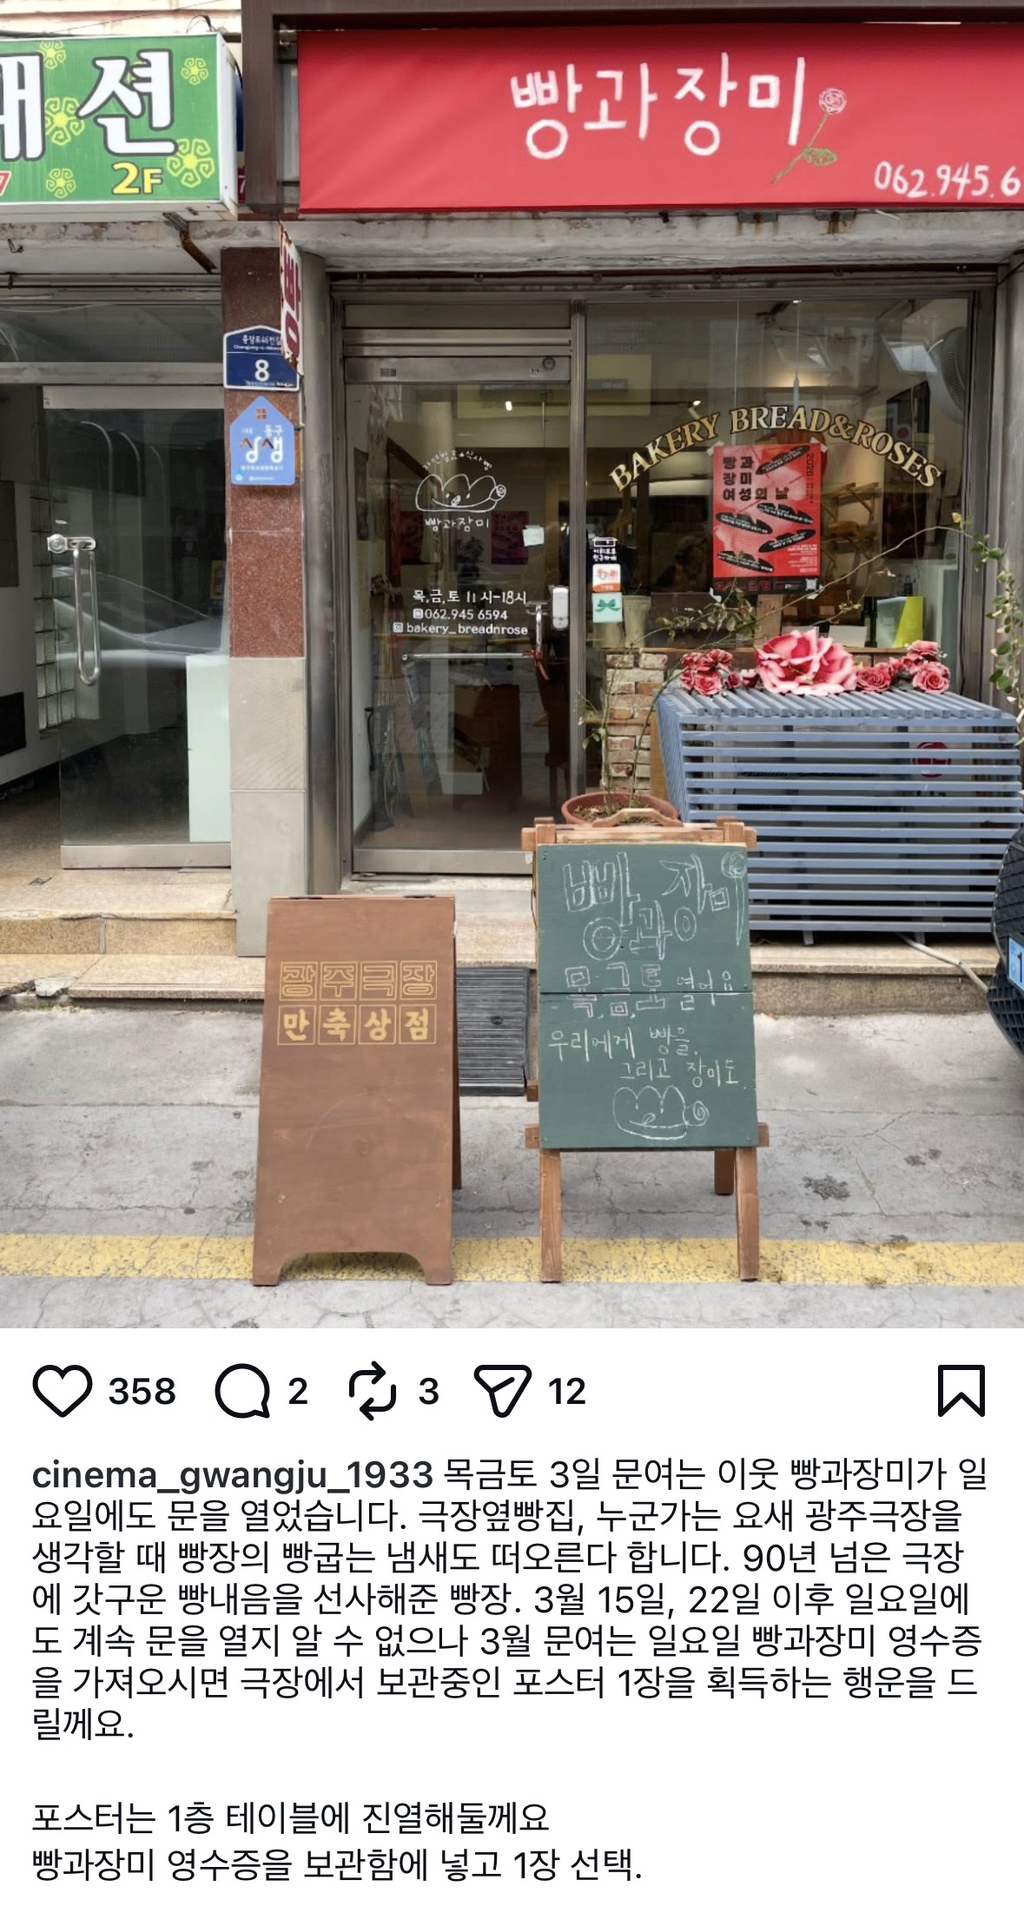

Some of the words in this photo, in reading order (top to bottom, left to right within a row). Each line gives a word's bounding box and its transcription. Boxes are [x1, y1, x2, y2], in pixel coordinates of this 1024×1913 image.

[510, 52, 806, 160] 빵과장미
[112, 161, 164, 196] 2F
[254, 358, 270, 382] 8
[609, 412, 721, 492] BAKERY
[730, 405, 944, 489] BREAD&ROSES
[425, 516, 489, 533] 빵과장미
[406, 622, 528, 635] bakery_breadnrose
[478, 609, 508, 620] 6594
[282, 963, 436, 998] 광주극장
[283, 1007, 429, 1042] 만축상점
[547, 1026, 635, 1063] 우리에게
[620, 1058, 672, 1082] 그리고
